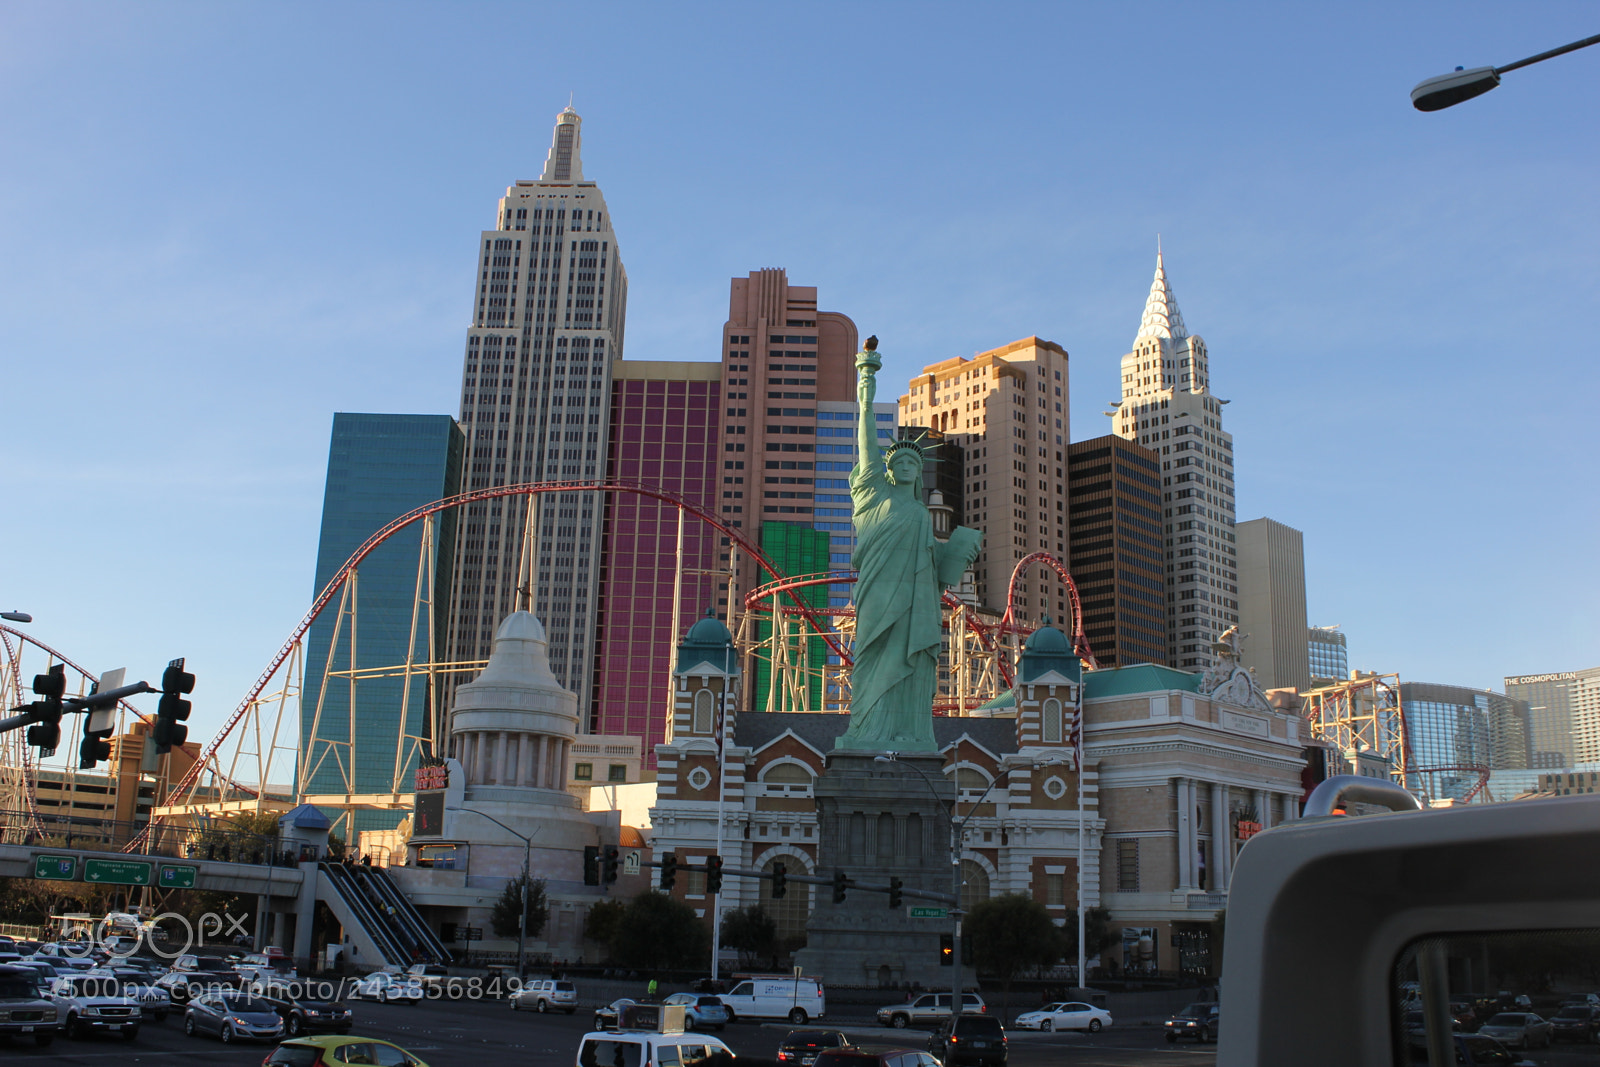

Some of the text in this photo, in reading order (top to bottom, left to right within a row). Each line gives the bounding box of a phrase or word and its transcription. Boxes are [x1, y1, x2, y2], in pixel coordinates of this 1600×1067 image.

[1504, 672, 1577, 686] THE COSMOPOLITAN
[415, 768, 429, 779] NEW
[414, 779, 428, 790] NEW
[60, 862, 71, 872] 15
[164, 870, 175, 880] 15
[636, 1014, 658, 1024] ONE
